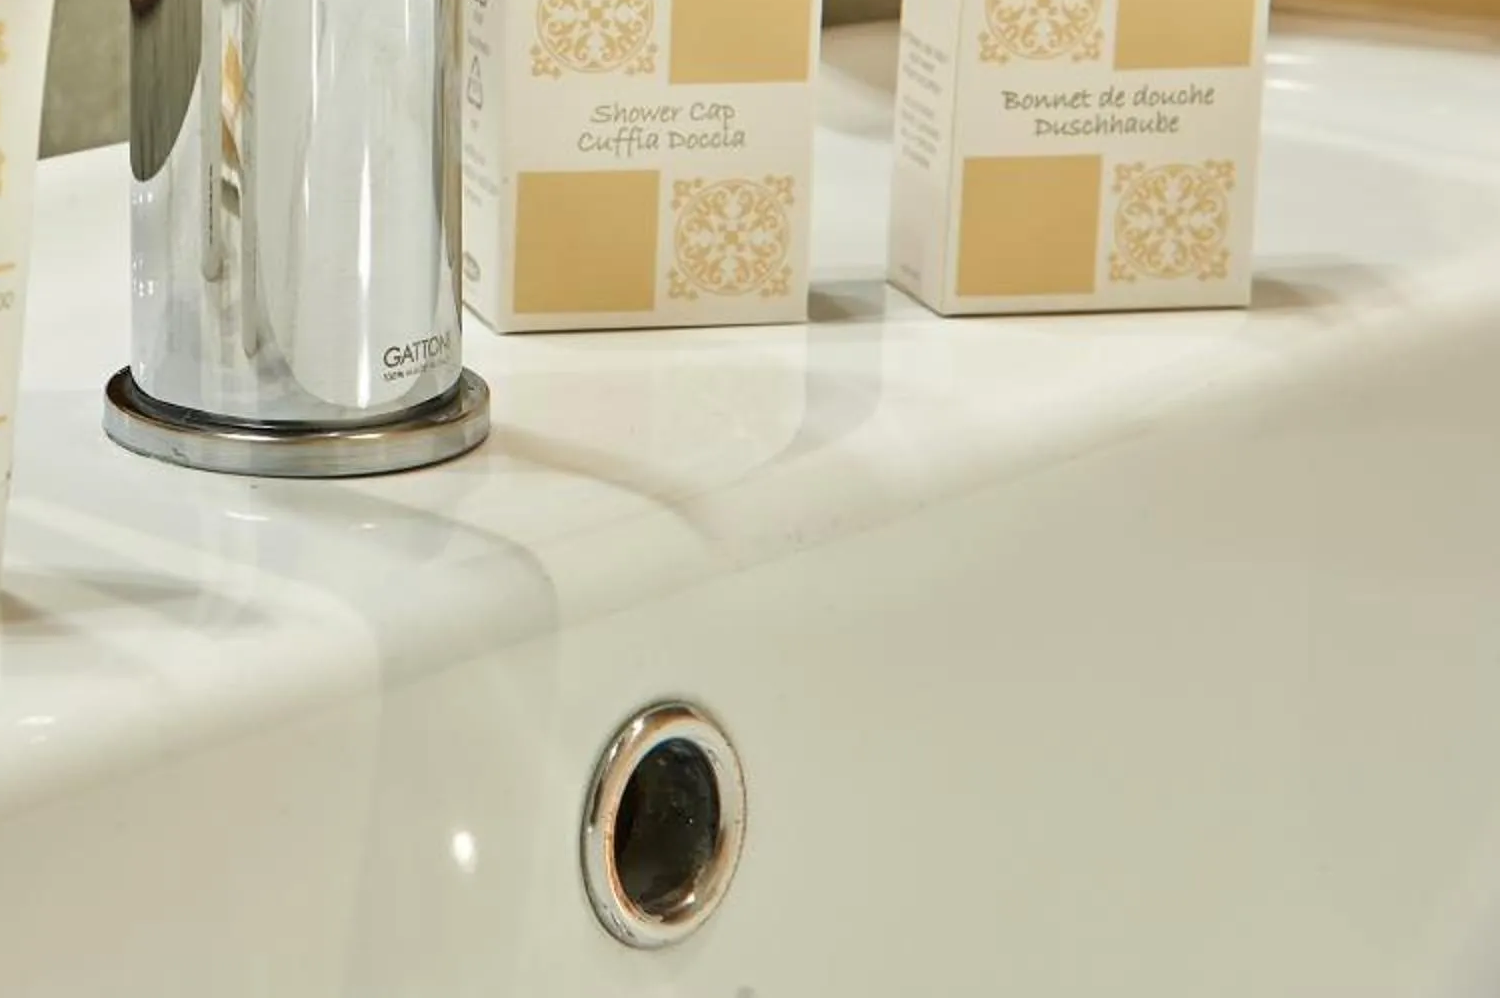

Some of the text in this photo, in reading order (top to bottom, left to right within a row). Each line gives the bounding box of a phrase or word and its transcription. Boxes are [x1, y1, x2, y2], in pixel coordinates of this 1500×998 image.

[1000, 83, 1216, 111] Bonnet de douche
[589, 101, 736, 130] Shower Cap
[1033, 111, 1181, 138] Duschhaube
[577, 125, 747, 158] Cuffia Doccia
